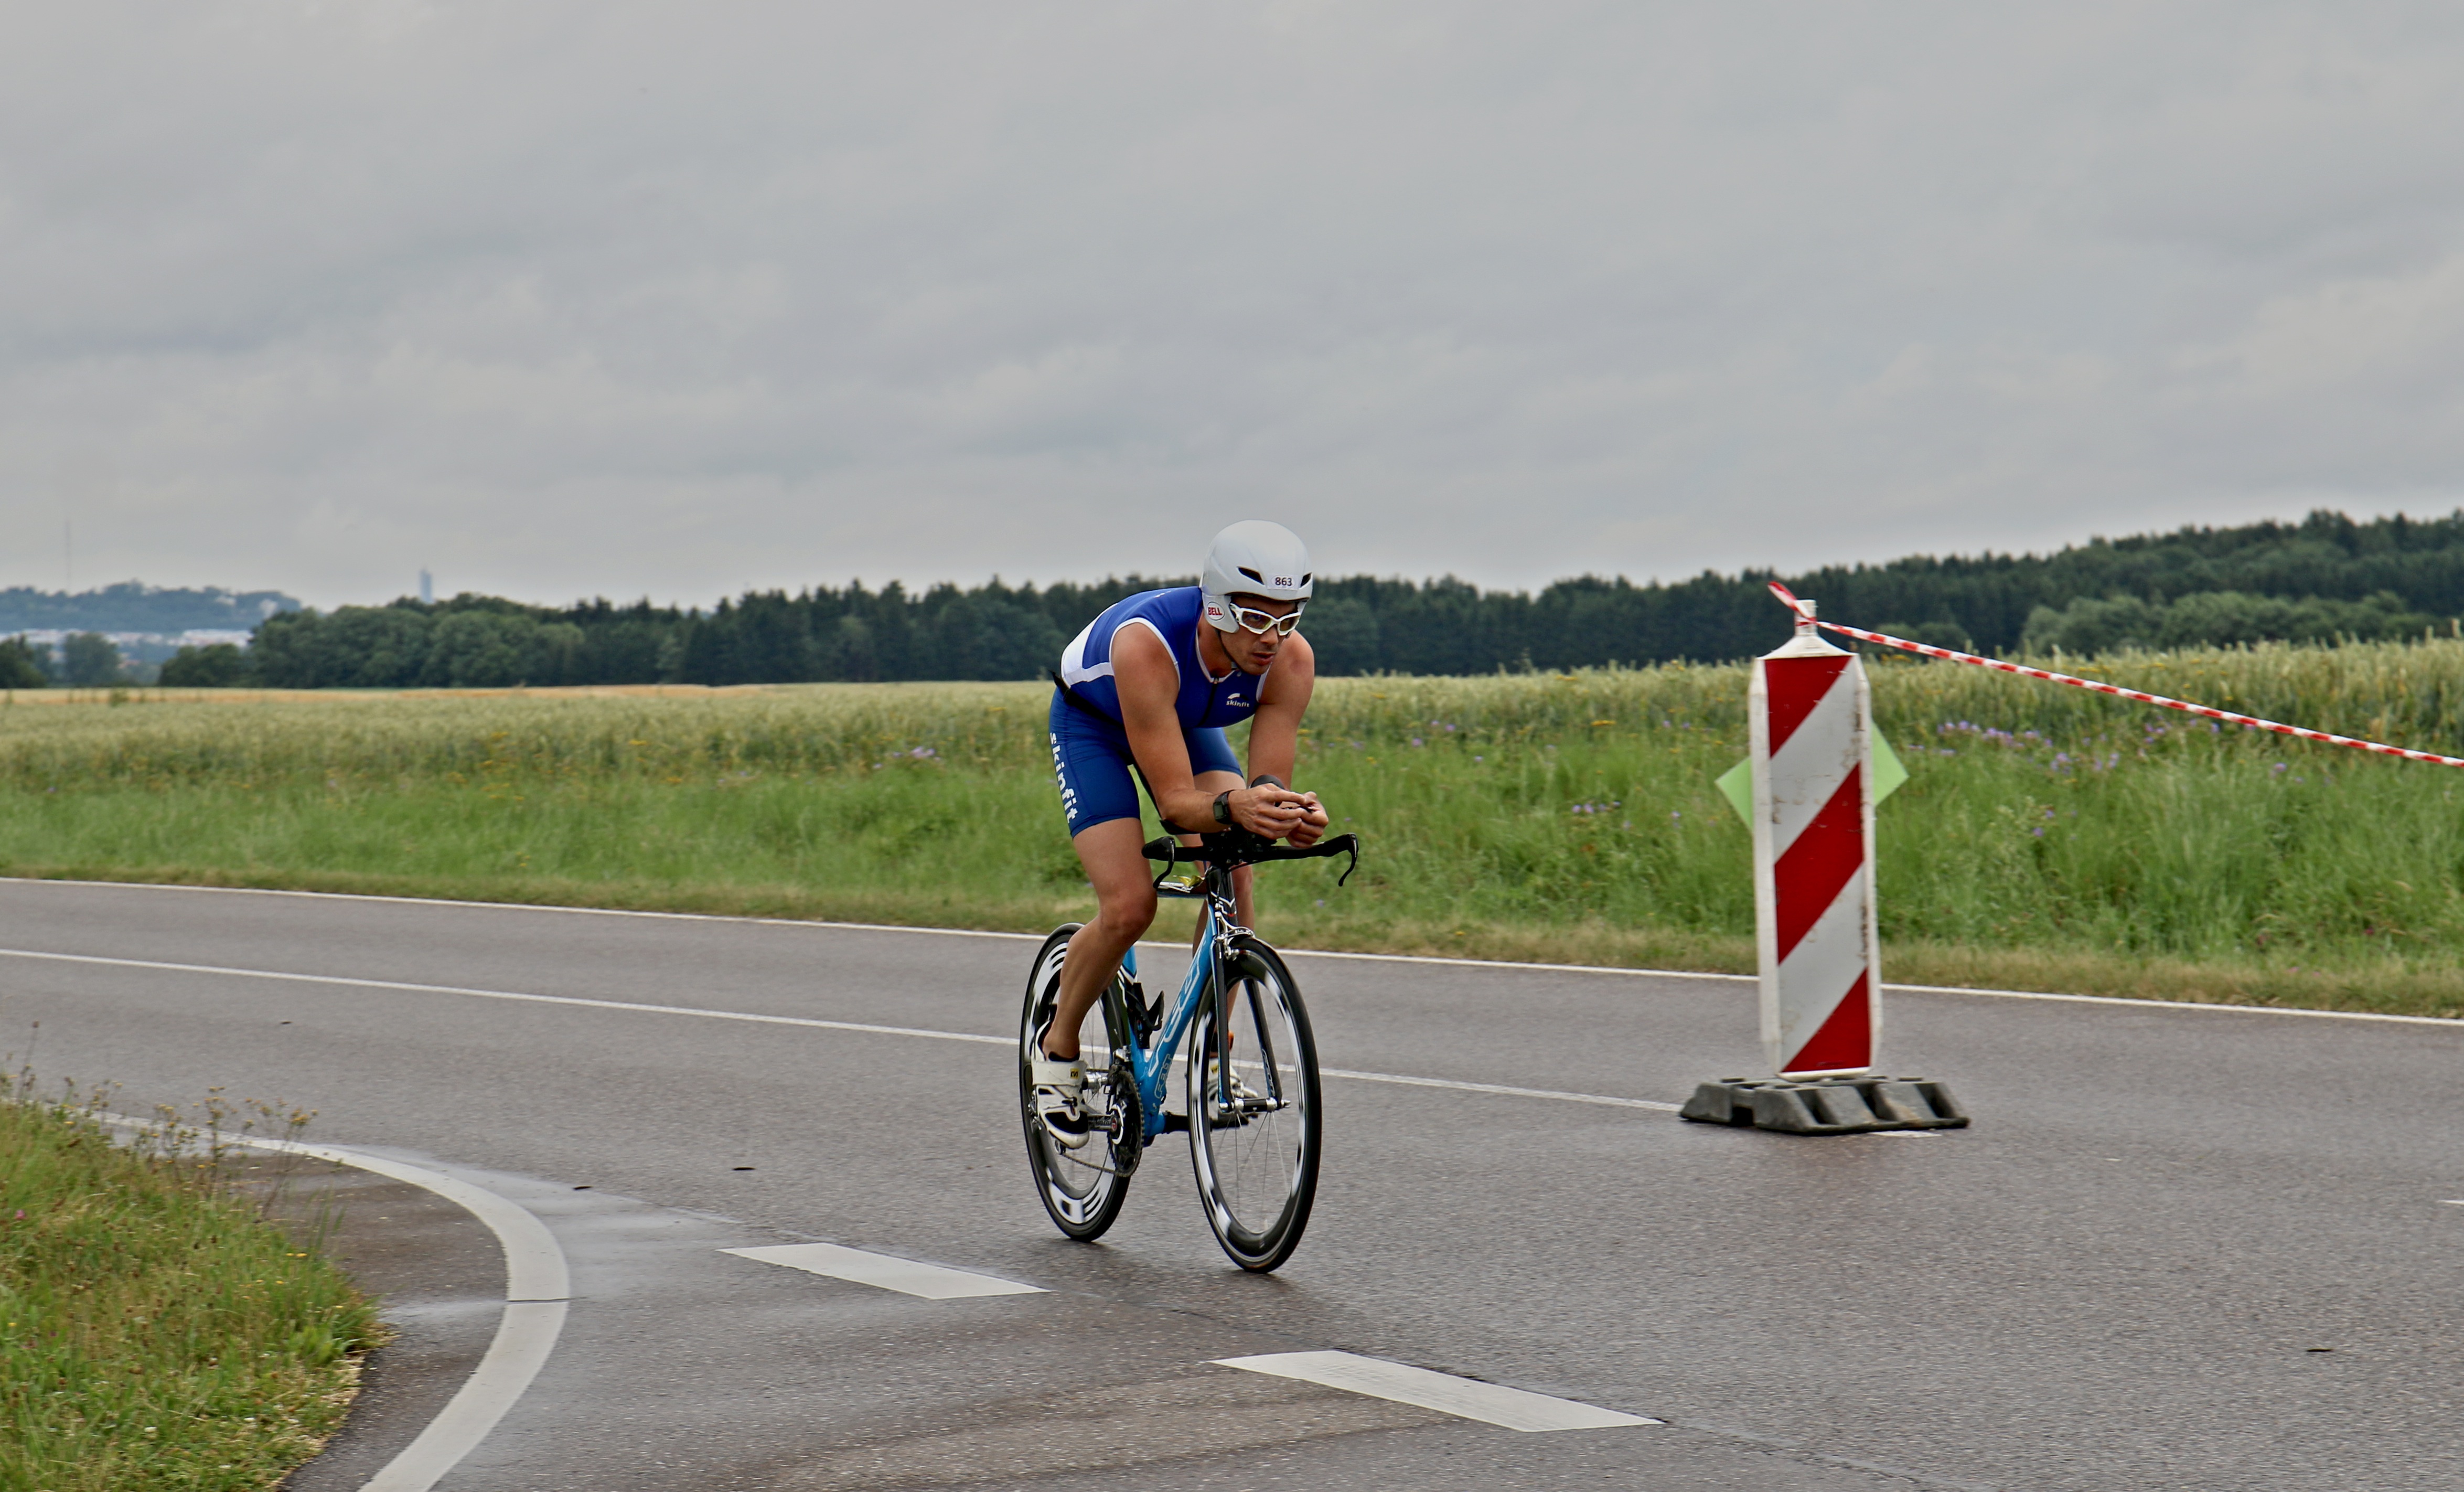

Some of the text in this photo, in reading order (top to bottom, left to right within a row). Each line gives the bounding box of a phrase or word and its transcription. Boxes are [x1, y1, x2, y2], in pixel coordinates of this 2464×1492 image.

[1275, 577, 1292, 586] 863
[1208, 607, 1223, 615] BELL
[1050, 732, 1078, 824] skinfit
